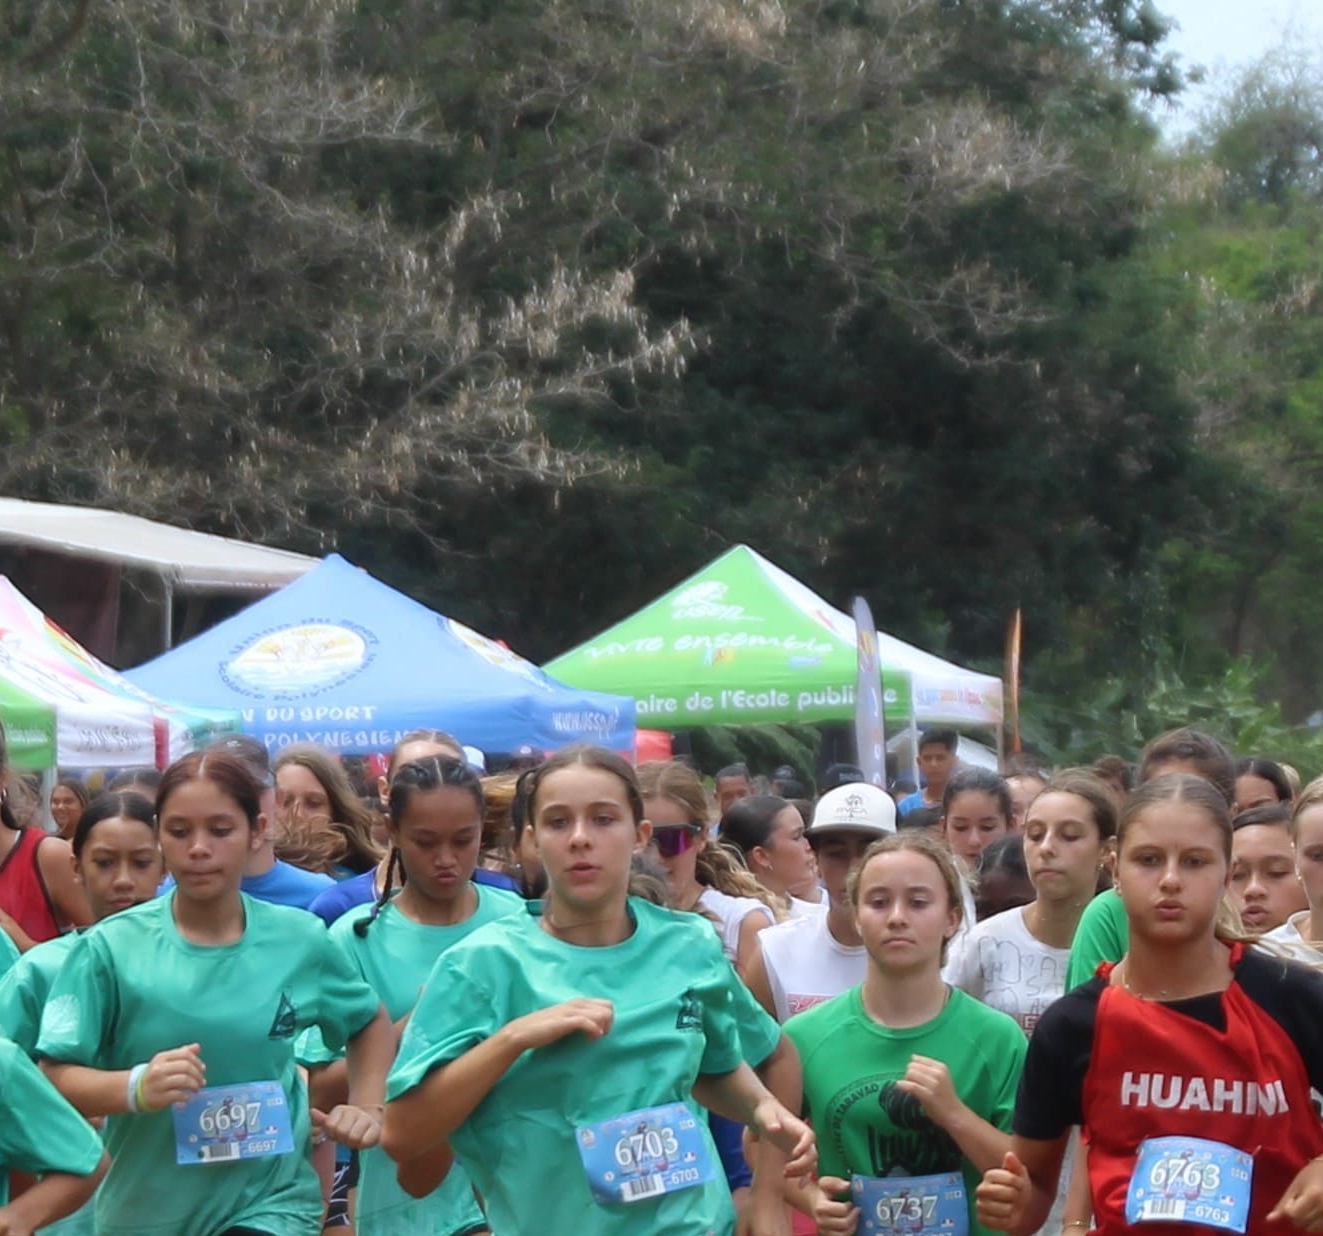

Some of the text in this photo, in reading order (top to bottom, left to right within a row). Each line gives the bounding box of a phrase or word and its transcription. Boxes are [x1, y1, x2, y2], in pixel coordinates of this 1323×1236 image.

[673, 630, 834, 654] ensemble
[685, 690, 715, 711] de
[796, 686, 899, 711] publie
[266, 706, 295, 723] DU
[299, 704, 377, 723] SPORT
[198, 1100, 264, 1133] 6697
[247, 1138, 278, 1155] 6697
[614, 1126, 679, 1167] 6703
[671, 1167, 700, 1186] 6703
[1149, 1157, 1223, 1192] 6763
[875, 1194, 939, 1223] 6737
[1194, 1204, 1231, 1224] 6763
